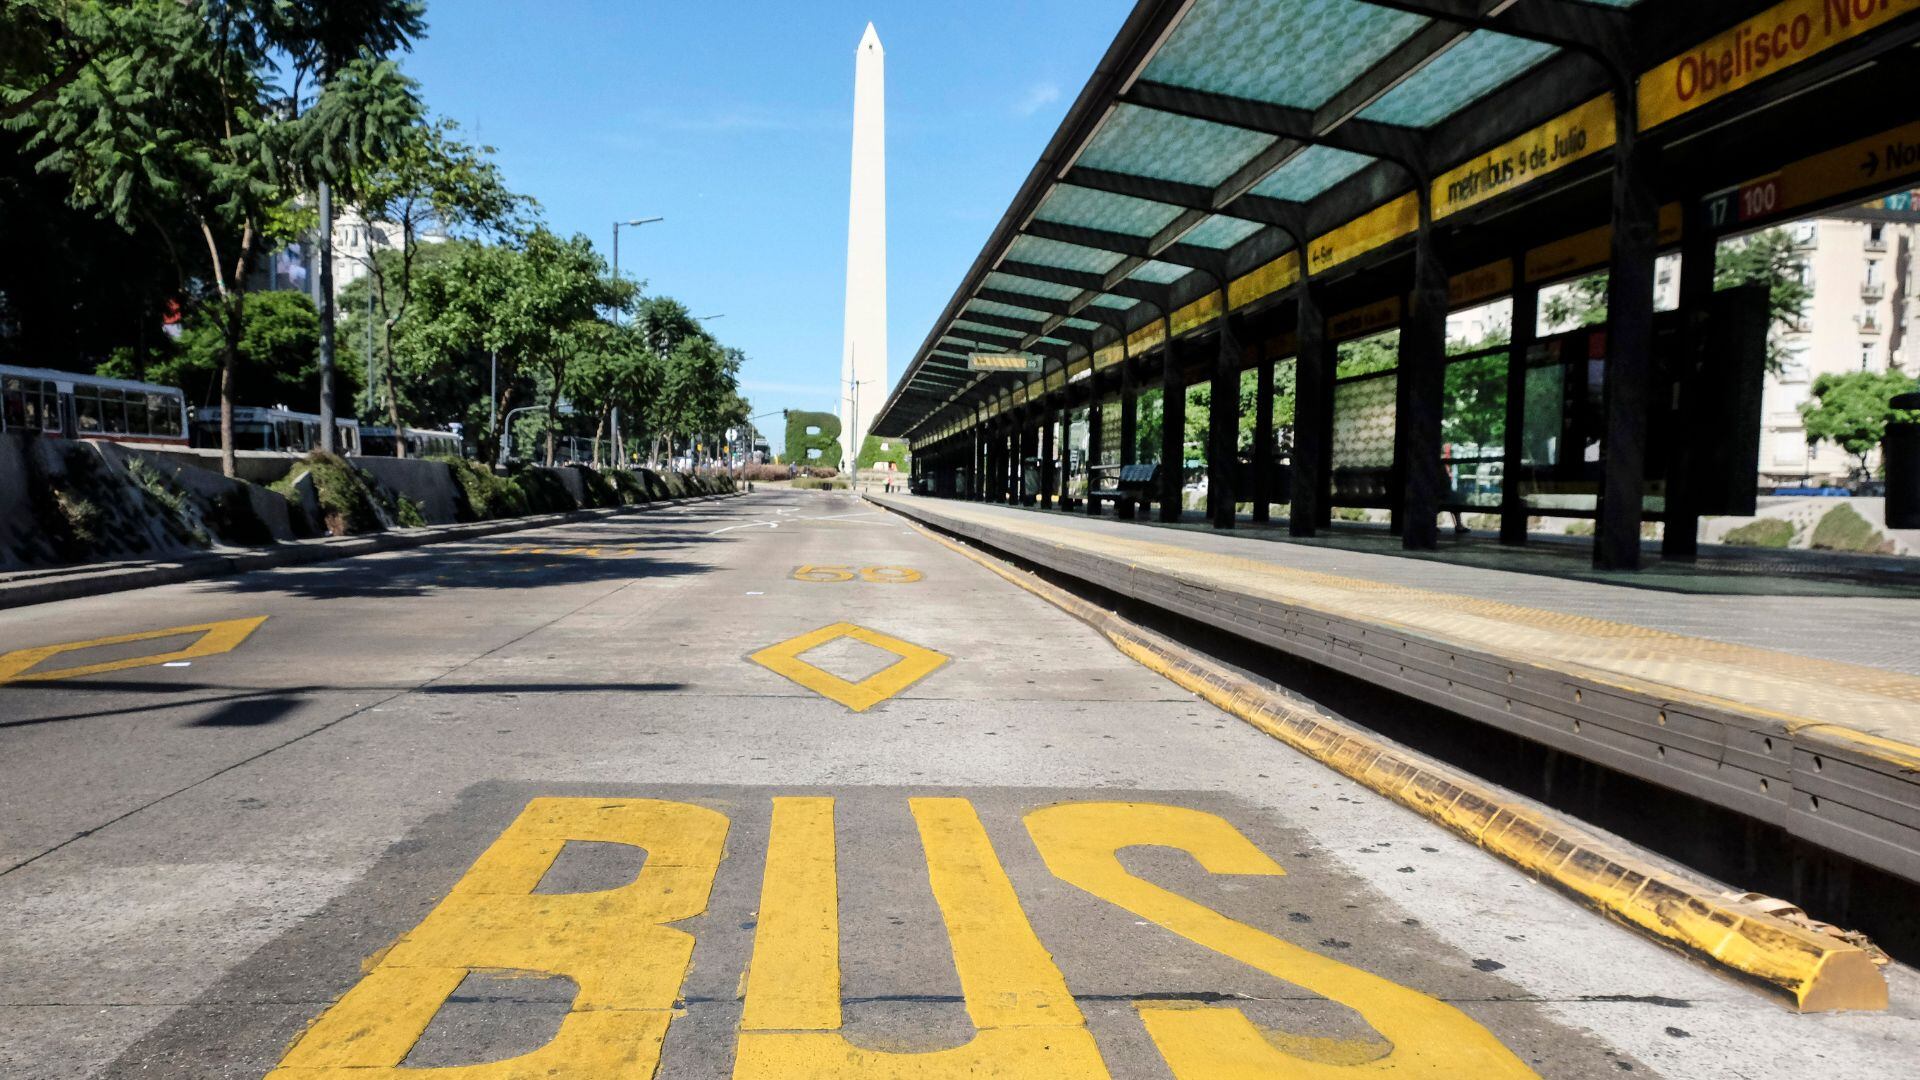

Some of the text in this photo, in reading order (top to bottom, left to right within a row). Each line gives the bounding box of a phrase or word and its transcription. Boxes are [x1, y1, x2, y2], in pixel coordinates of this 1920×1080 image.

[1677, 0, 1888, 101] Obelisco No
[1519, 150, 1527, 175] 9
[1530, 144, 1546, 170] de
[1550, 125, 1587, 161] Julio
[1710, 183, 1776, 226] 17 100
[793, 564, 922, 583] 59
[264, 796, 1546, 1080] BUS
